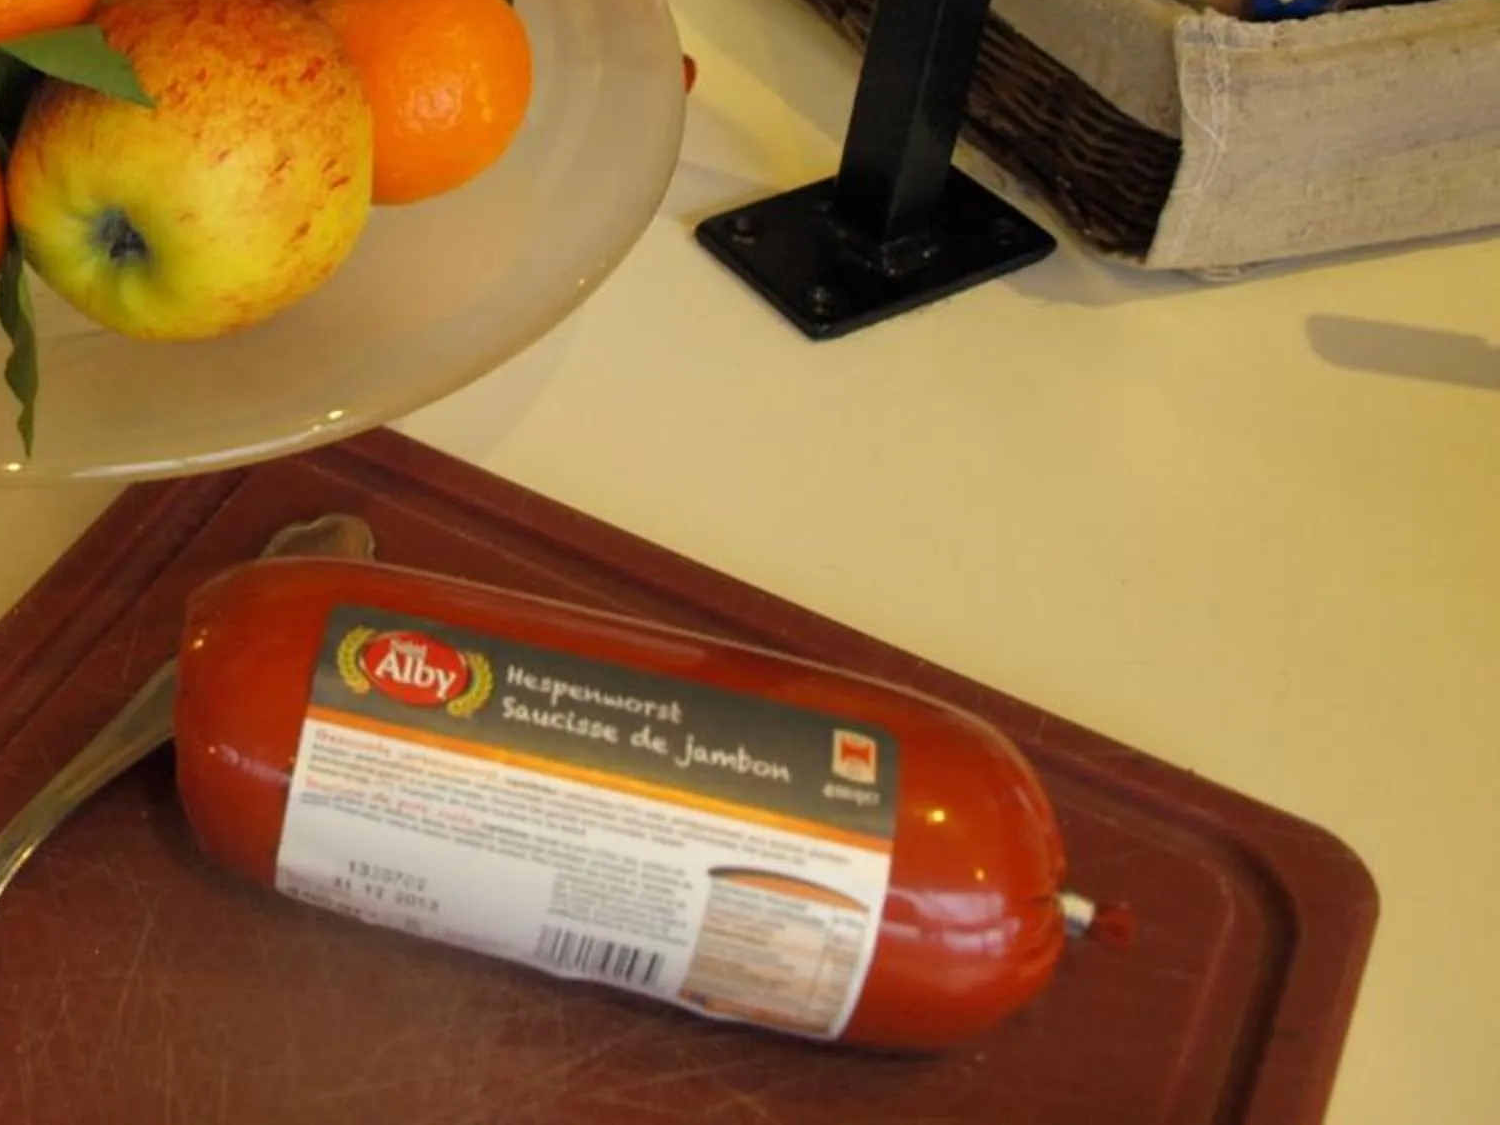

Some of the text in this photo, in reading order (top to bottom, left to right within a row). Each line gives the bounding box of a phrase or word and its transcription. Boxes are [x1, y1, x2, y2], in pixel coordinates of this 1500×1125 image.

[375, 652, 457, 700] Alby
[507, 664, 682, 724] Hespenworst
[502, 695, 792, 783] Saucisse de jambon
